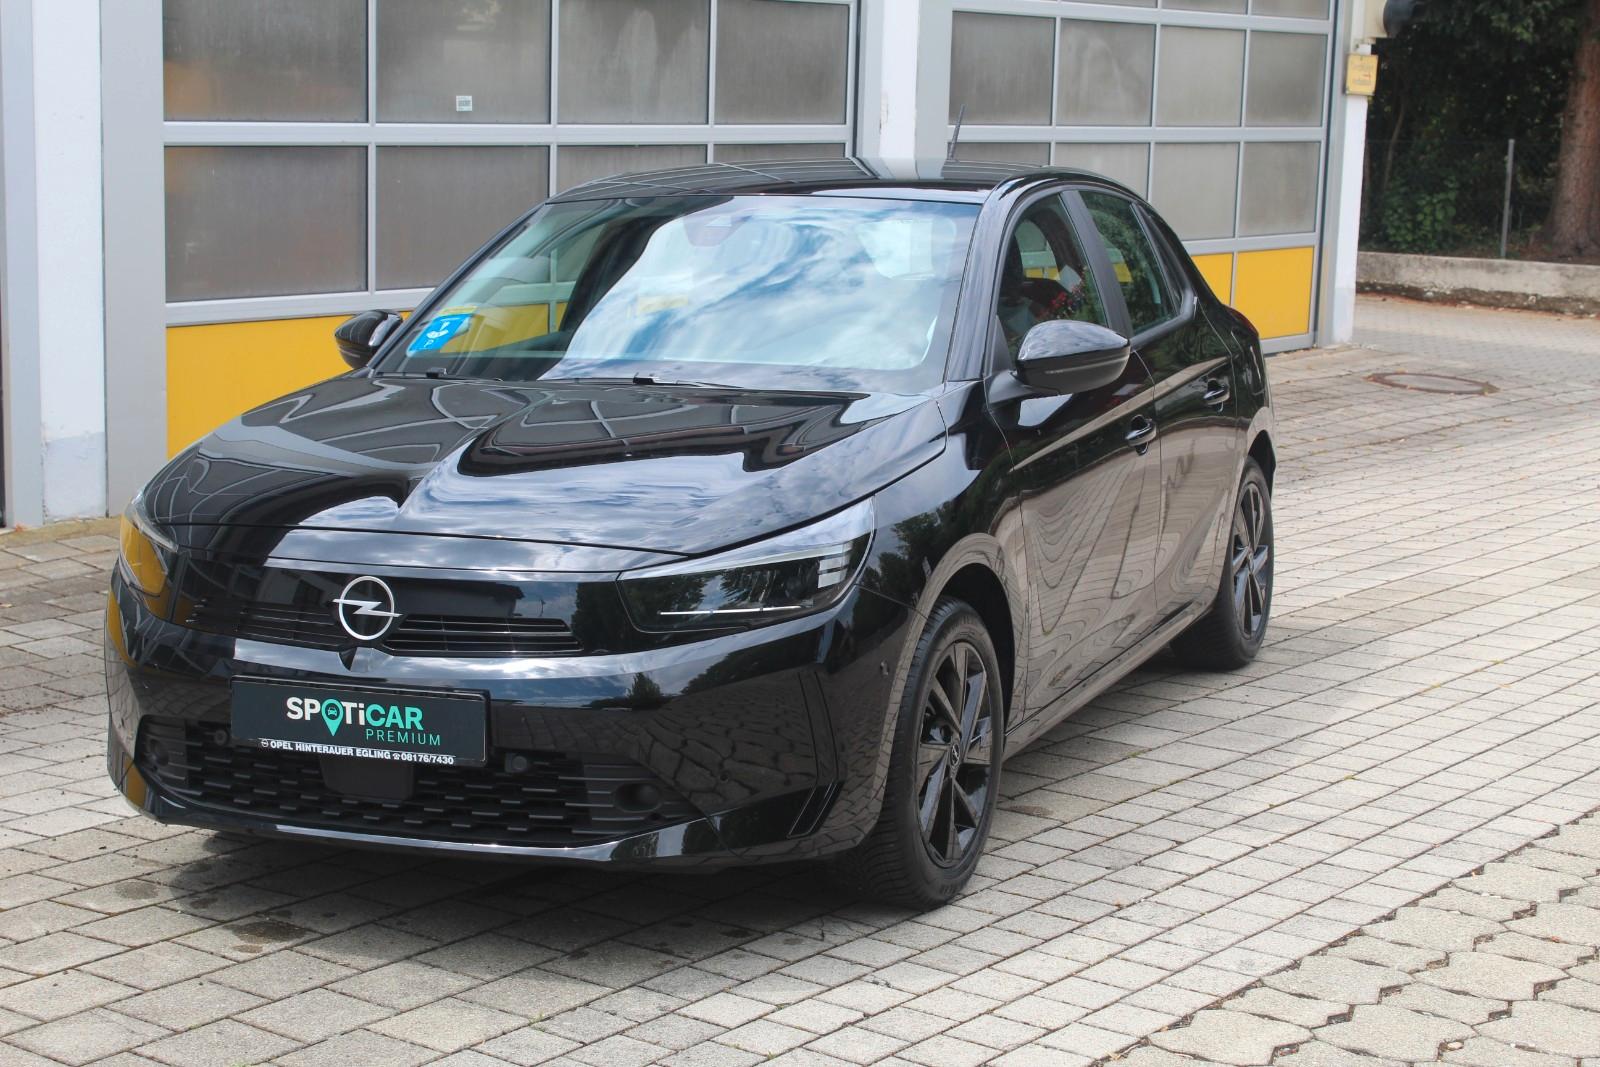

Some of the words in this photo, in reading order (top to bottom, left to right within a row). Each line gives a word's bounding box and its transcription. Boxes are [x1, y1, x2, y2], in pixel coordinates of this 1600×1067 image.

[366, 728, 441, 746] PREMIUM
[270, 740, 293, 750] OPEL
[295, 742, 354, 756] HINTERAUER
[356, 748, 391, 759] EGLING
[401, 753, 454, 765] 08176/7430
